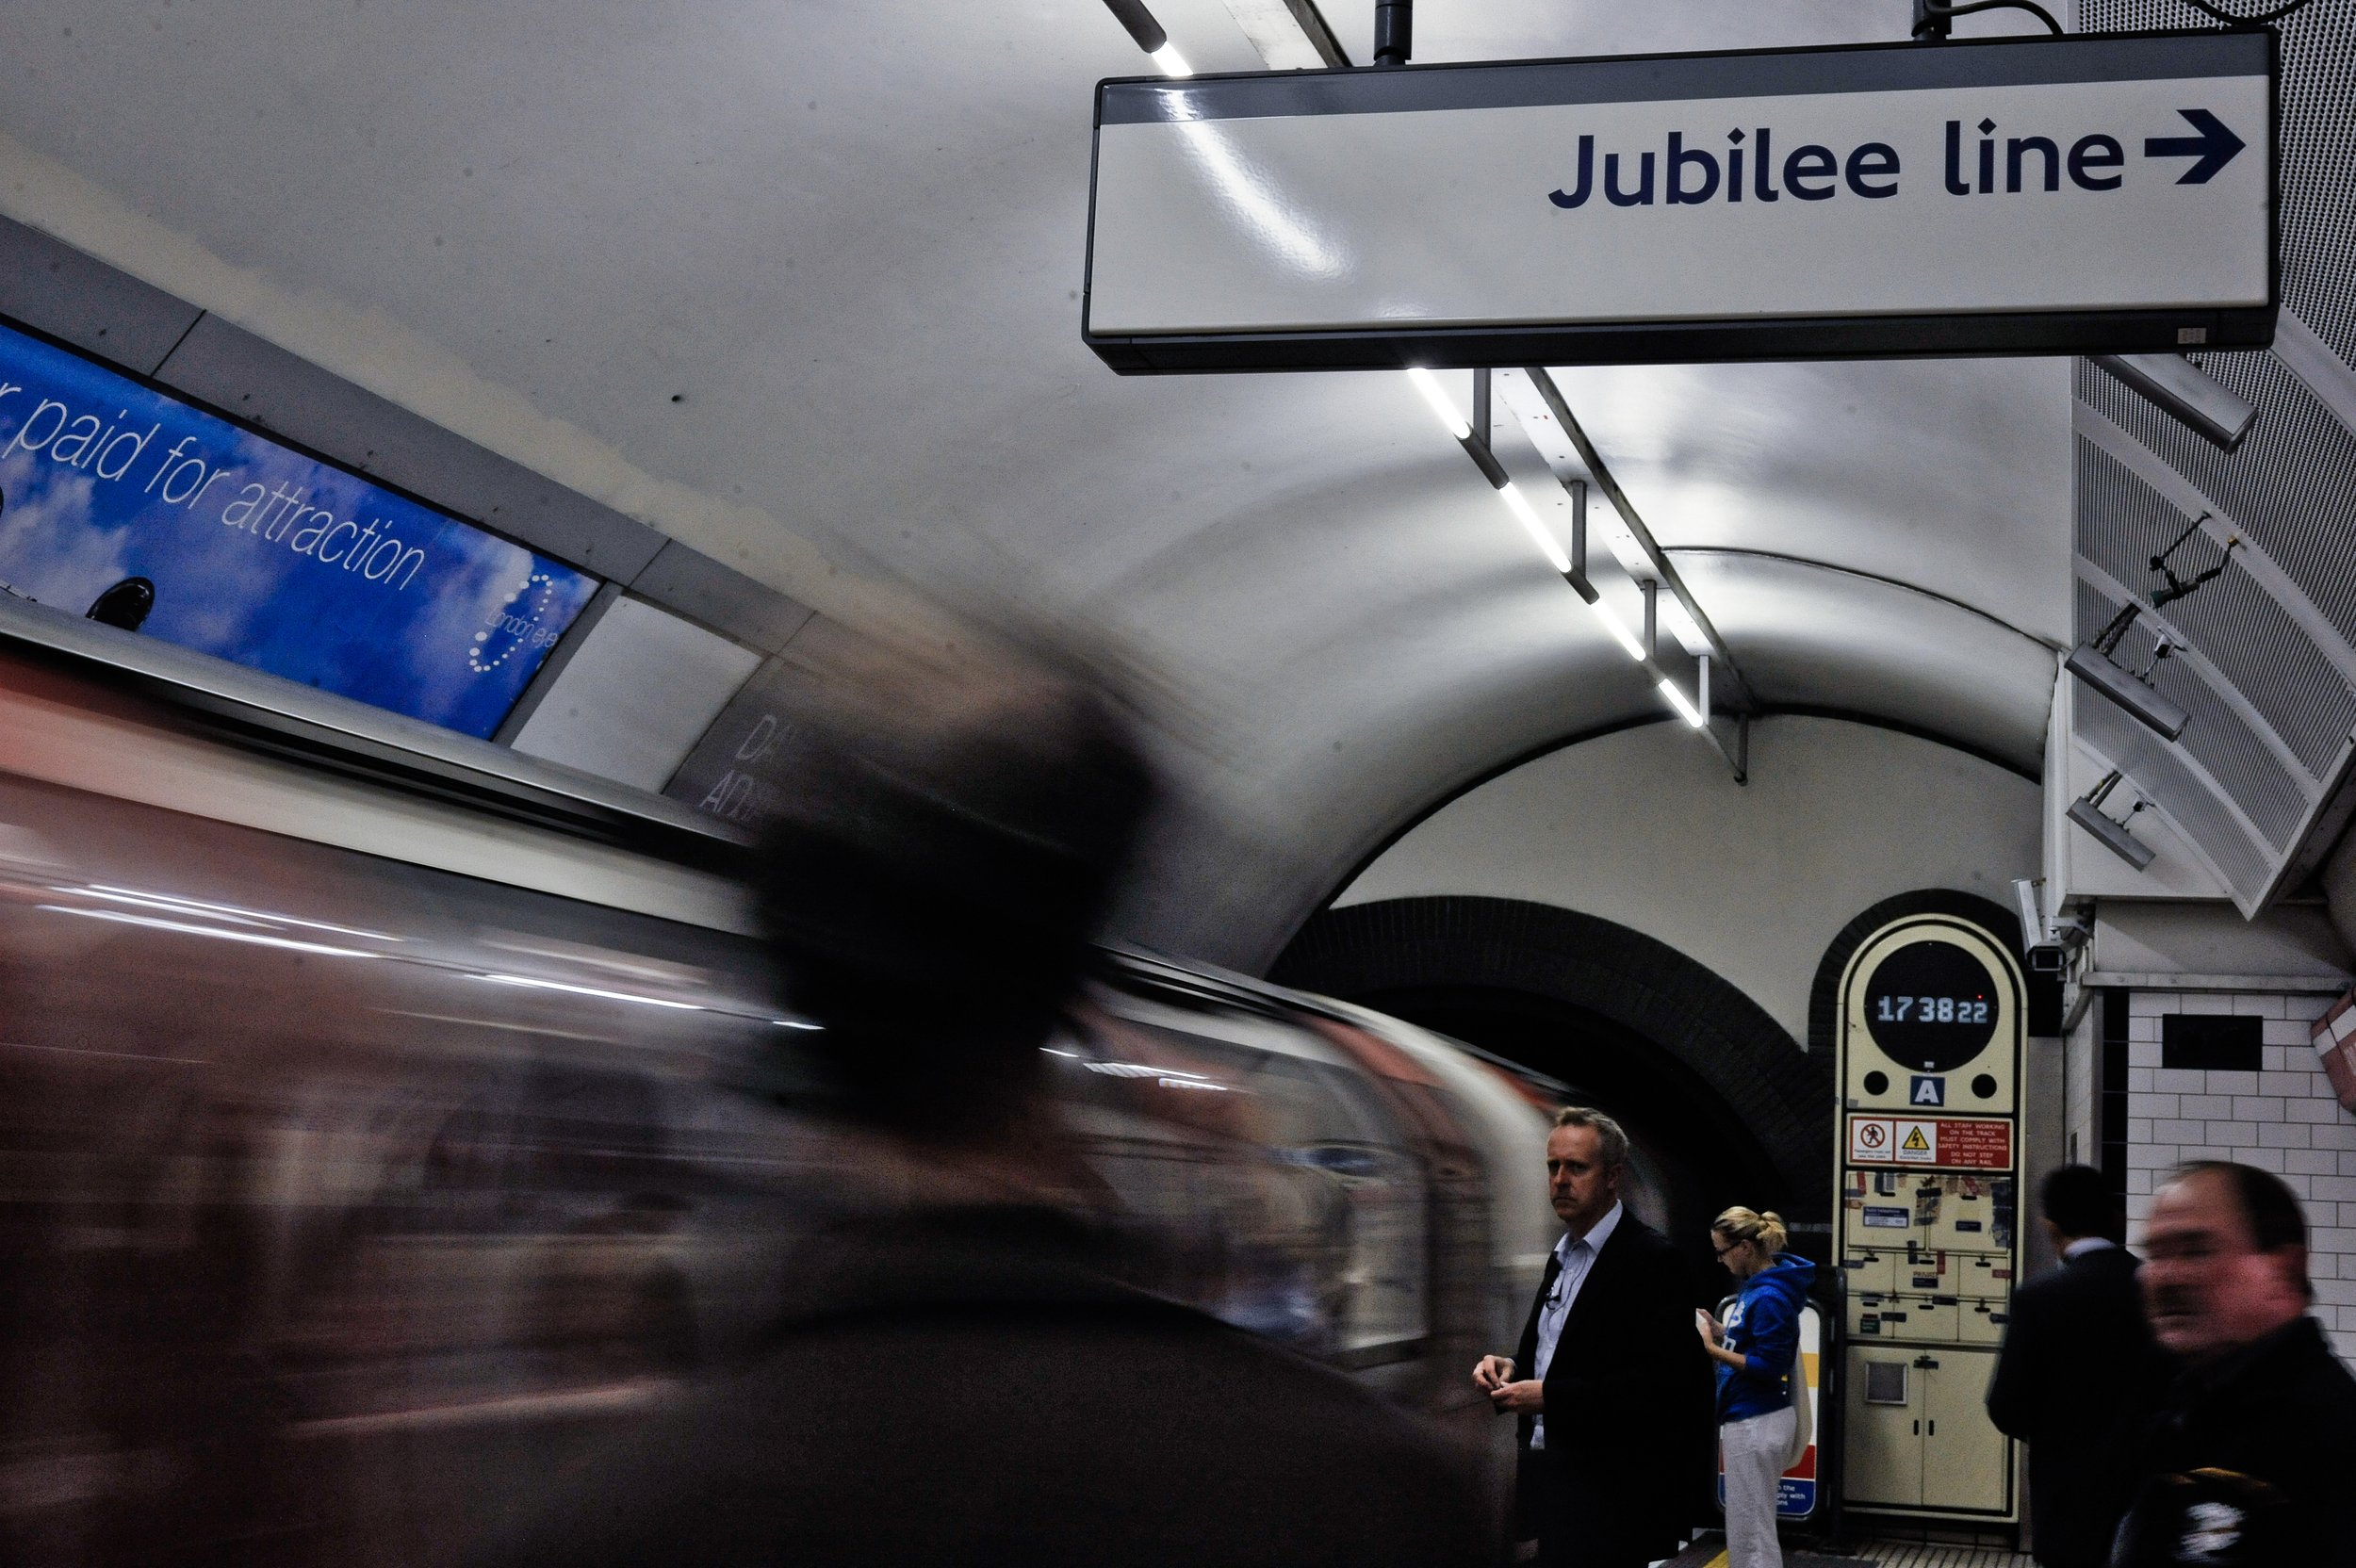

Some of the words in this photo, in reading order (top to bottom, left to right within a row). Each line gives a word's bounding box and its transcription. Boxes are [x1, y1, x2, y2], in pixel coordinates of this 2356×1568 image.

[1548, 127, 1901, 209] Jubilee
[1945, 117, 2125, 196] line
[2, 398, 161, 482] paid
[144, 436, 231, 510] for
[221, 481, 425, 591] attraction
[1877, 995, 1914, 1022] 17
[1918, 996, 1955, 1023] 38
[1957, 1001, 1988, 1024] 22
[1914, 1079, 1940, 1104] A
